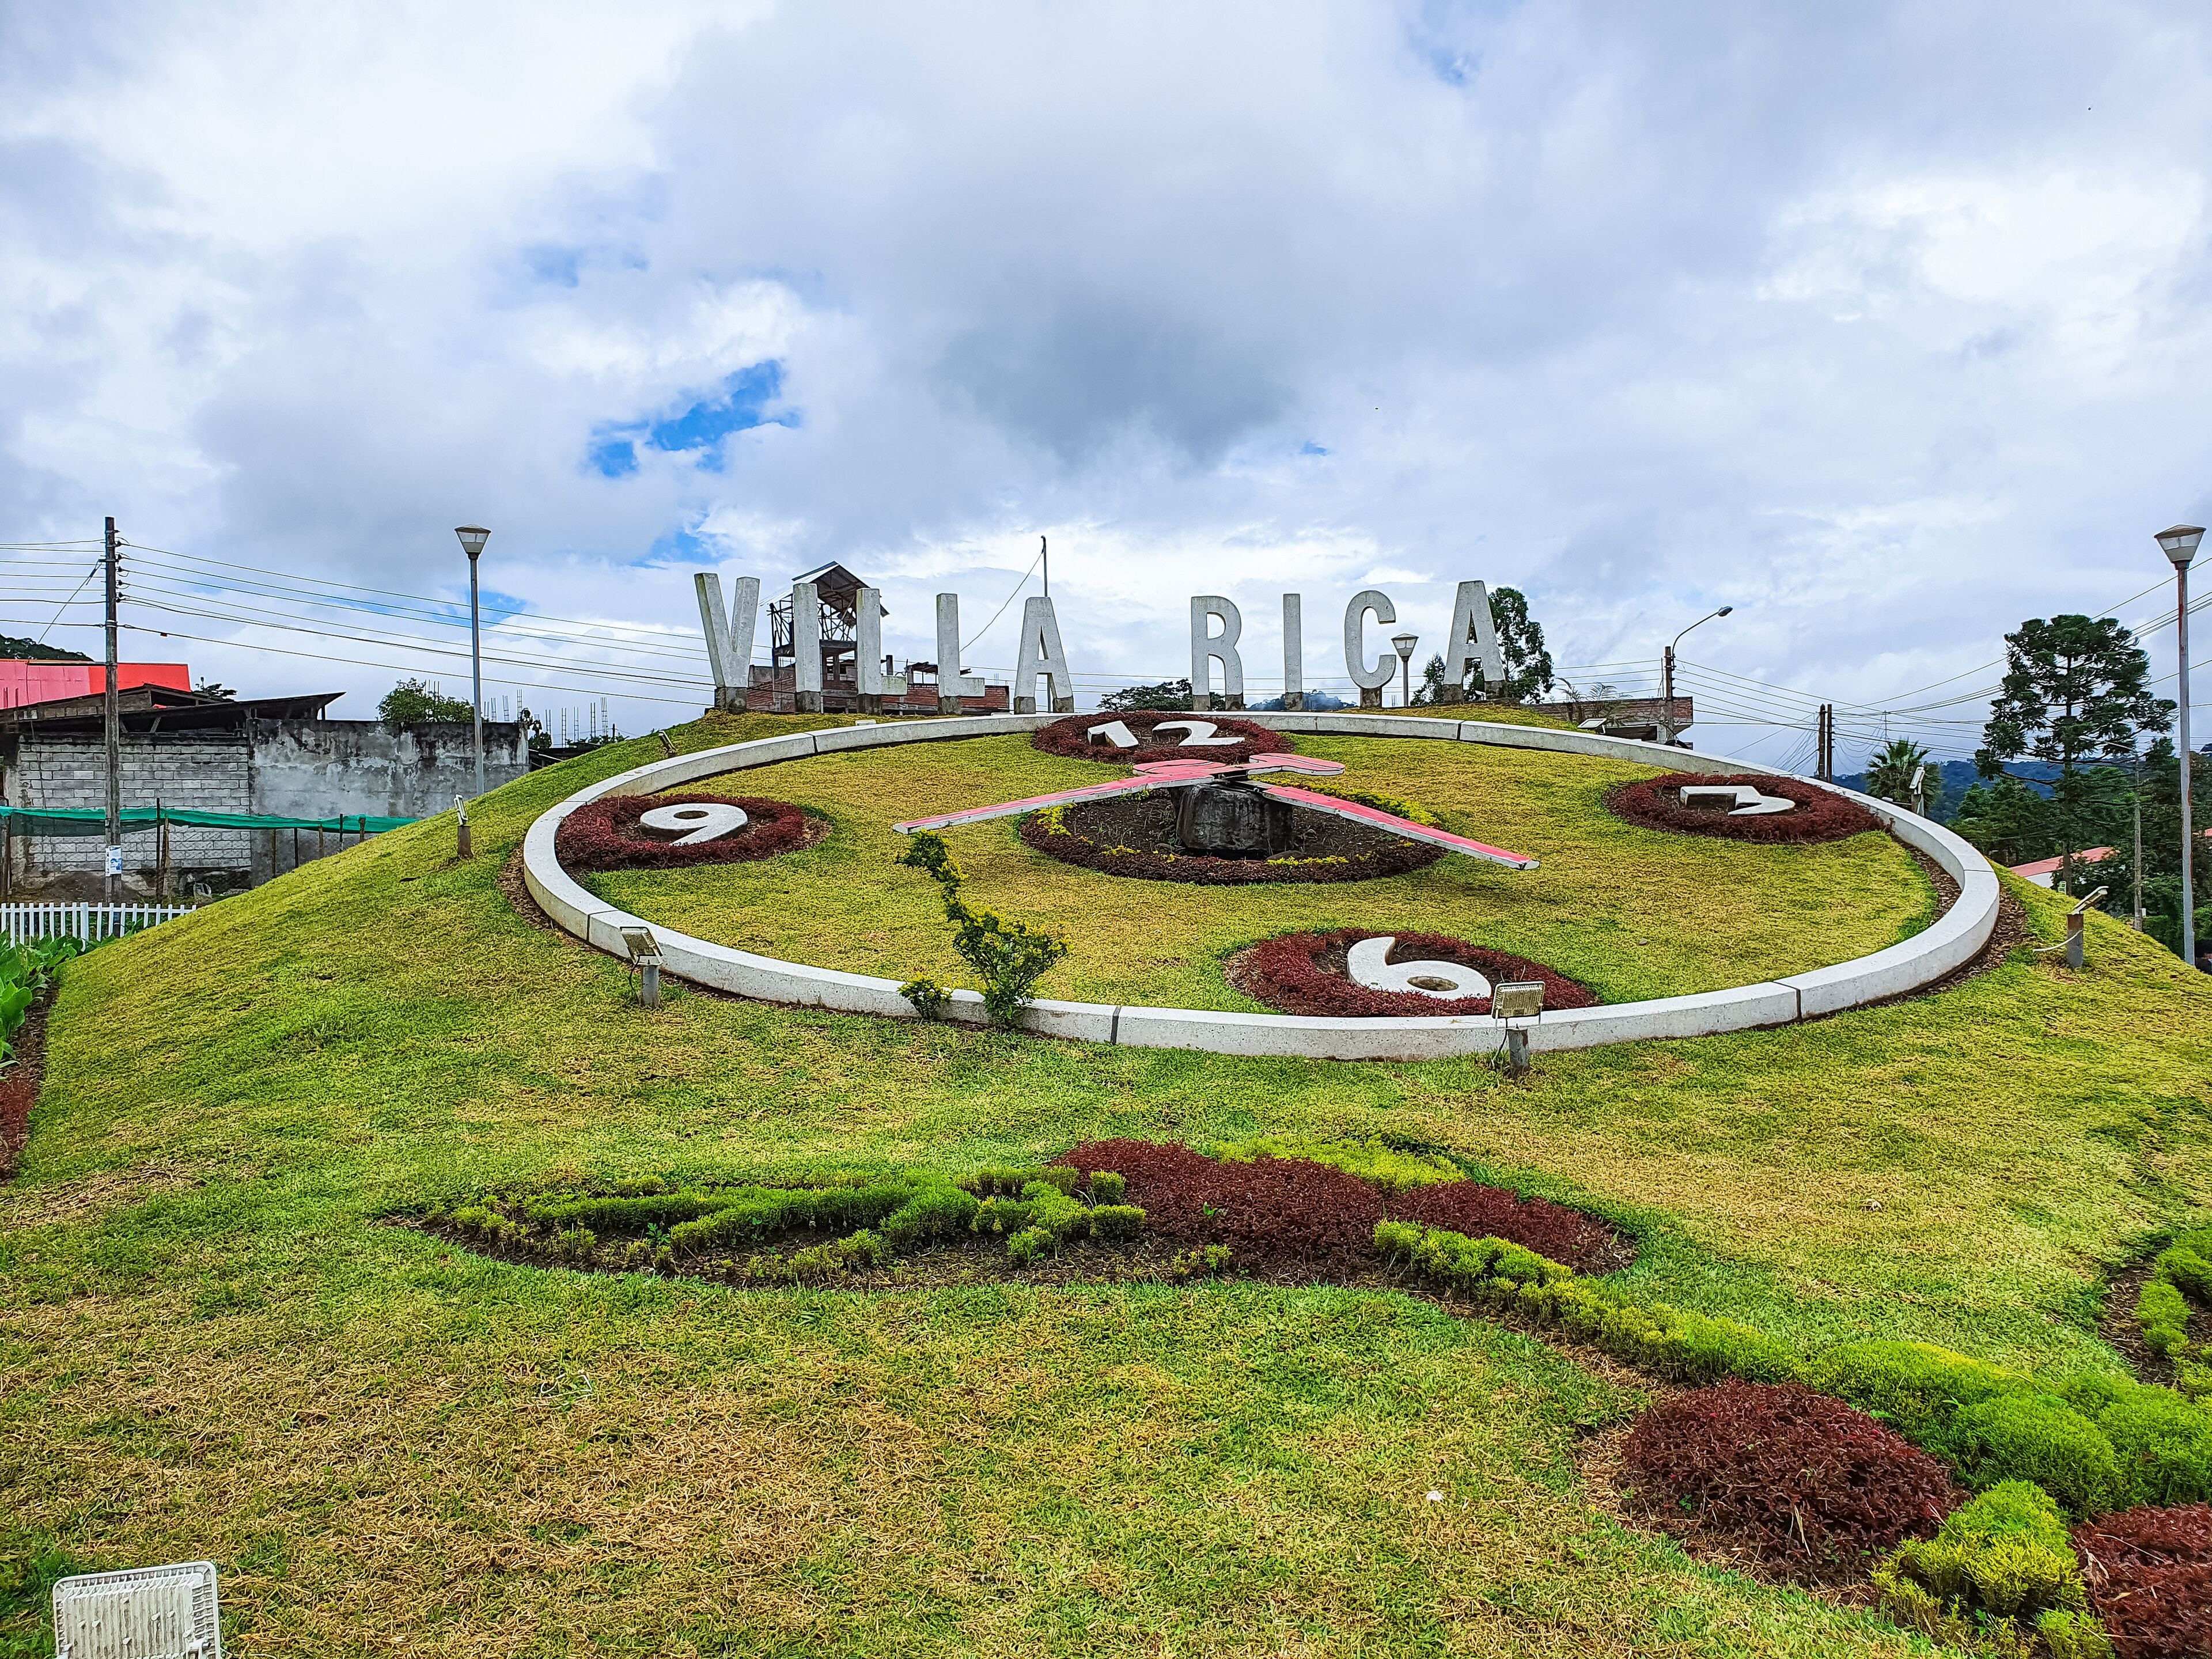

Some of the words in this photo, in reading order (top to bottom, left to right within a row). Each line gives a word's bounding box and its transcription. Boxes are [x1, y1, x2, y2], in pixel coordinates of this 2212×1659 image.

[694, 573, 1074, 714] VILLA
[1191, 581, 1508, 711] RICA
[1088, 720, 1245, 748] 12
[640, 802, 748, 846] 9
[1347, 936, 1492, 1001] 6
